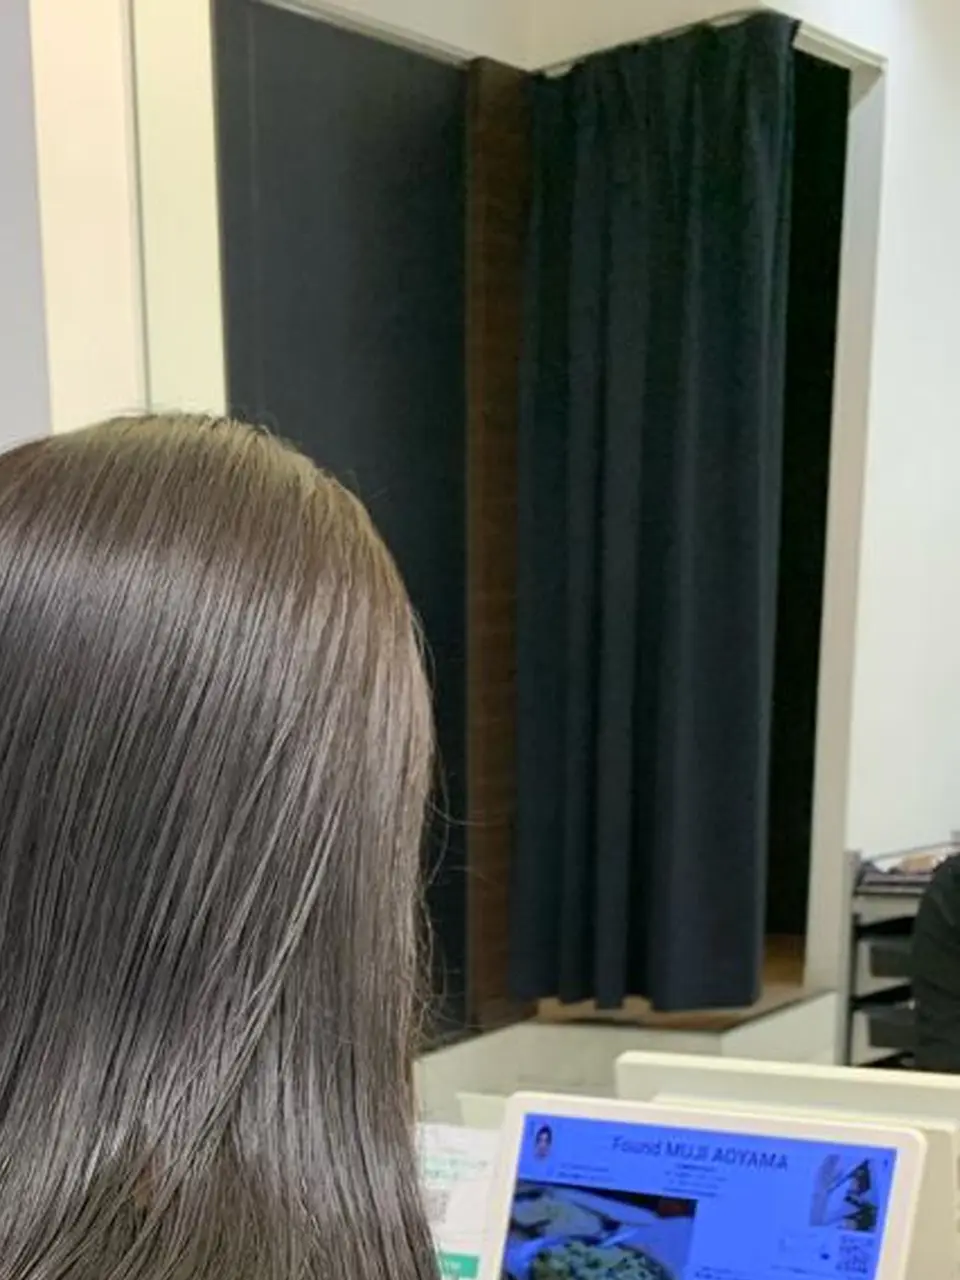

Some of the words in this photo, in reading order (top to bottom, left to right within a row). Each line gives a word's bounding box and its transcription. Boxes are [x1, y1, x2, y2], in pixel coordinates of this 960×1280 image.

[611, 1136, 662, 1157] Found
[665, 1141, 709, 1161] MUJI
[712, 1146, 789, 1169] AOYAMA
